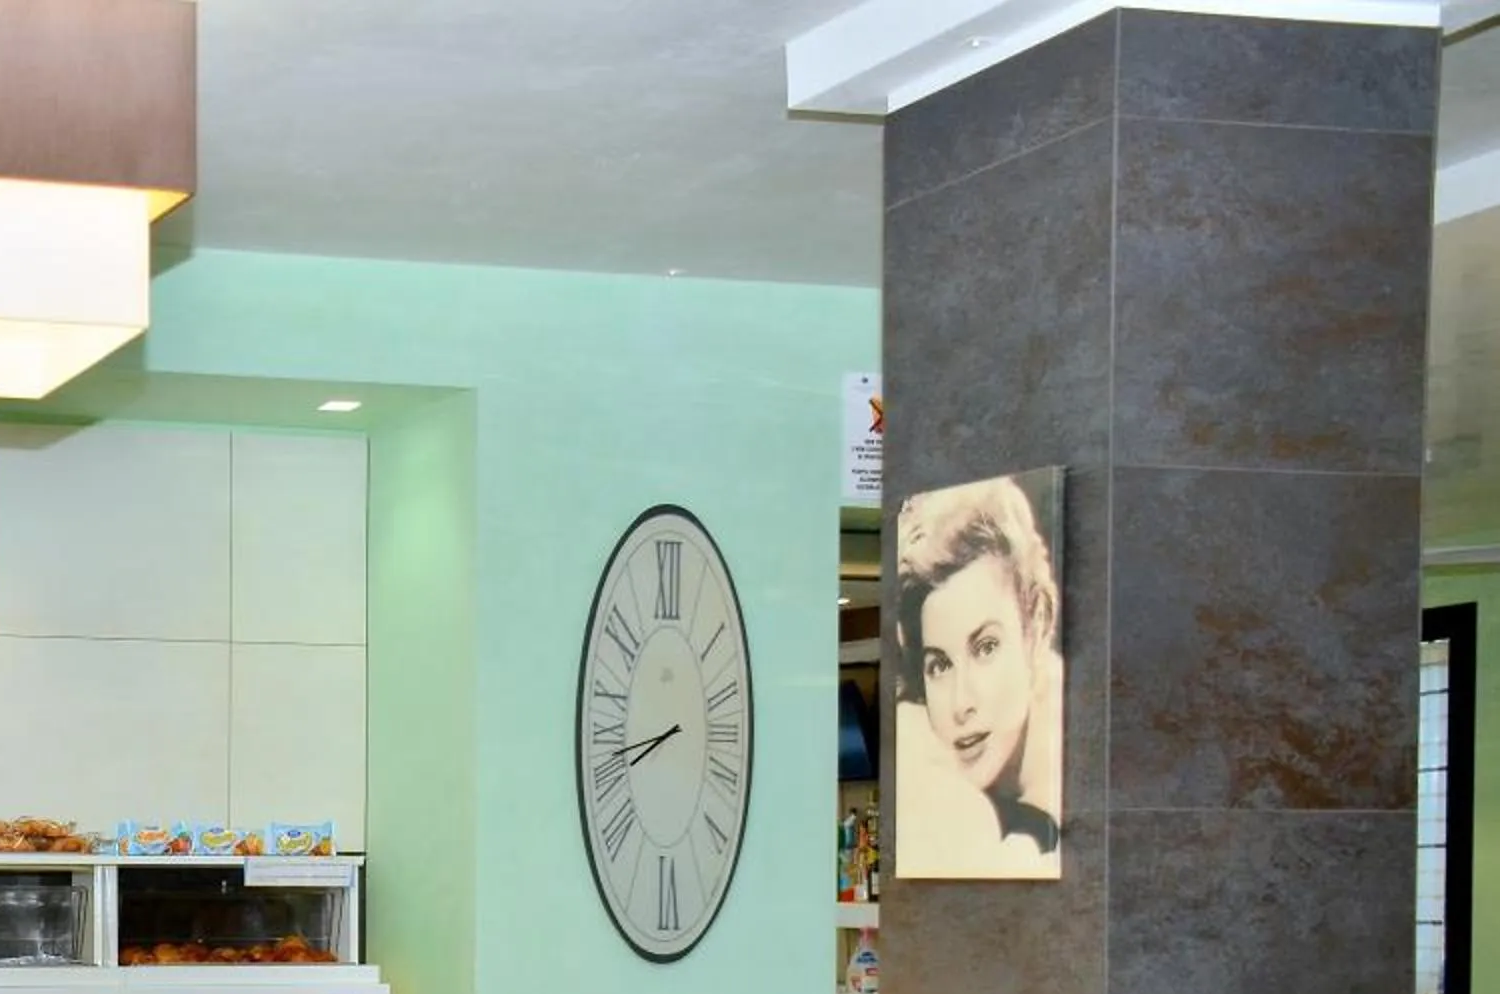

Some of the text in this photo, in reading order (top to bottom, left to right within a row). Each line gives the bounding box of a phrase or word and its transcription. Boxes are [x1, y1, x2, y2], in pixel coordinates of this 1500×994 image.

[654, 539, 683, 620] XII
[604, 603, 640, 673] XI
[700, 622, 726, 662] I
[593, 679, 628, 712] X
[707, 680, 738, 712] II
[592, 720, 626, 745] IX
[657, 855, 680, 931] VI
